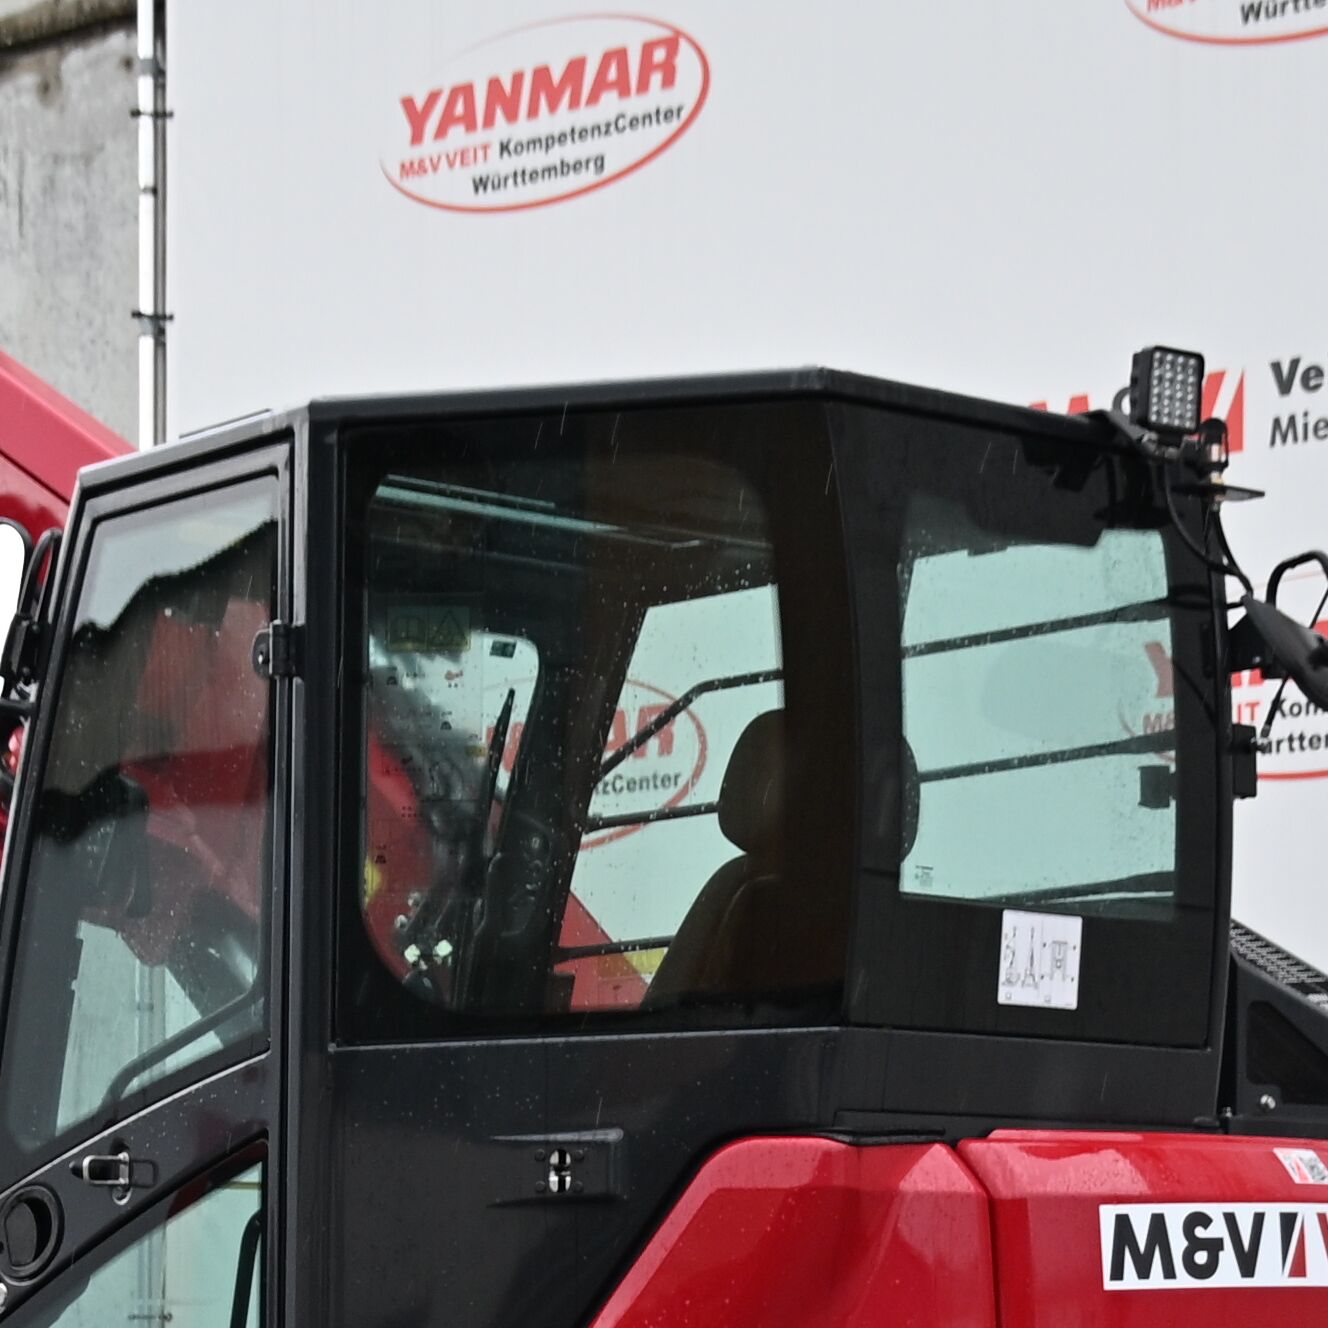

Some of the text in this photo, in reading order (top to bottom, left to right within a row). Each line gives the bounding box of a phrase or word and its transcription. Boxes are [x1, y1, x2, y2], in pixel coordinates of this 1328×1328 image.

[399, 33, 681, 147] YANMAR
[498, 105, 684, 158] KompetenzCenter
[472, 153, 606, 195] Württemberg
[1109, 1211, 1265, 1281] M&V
